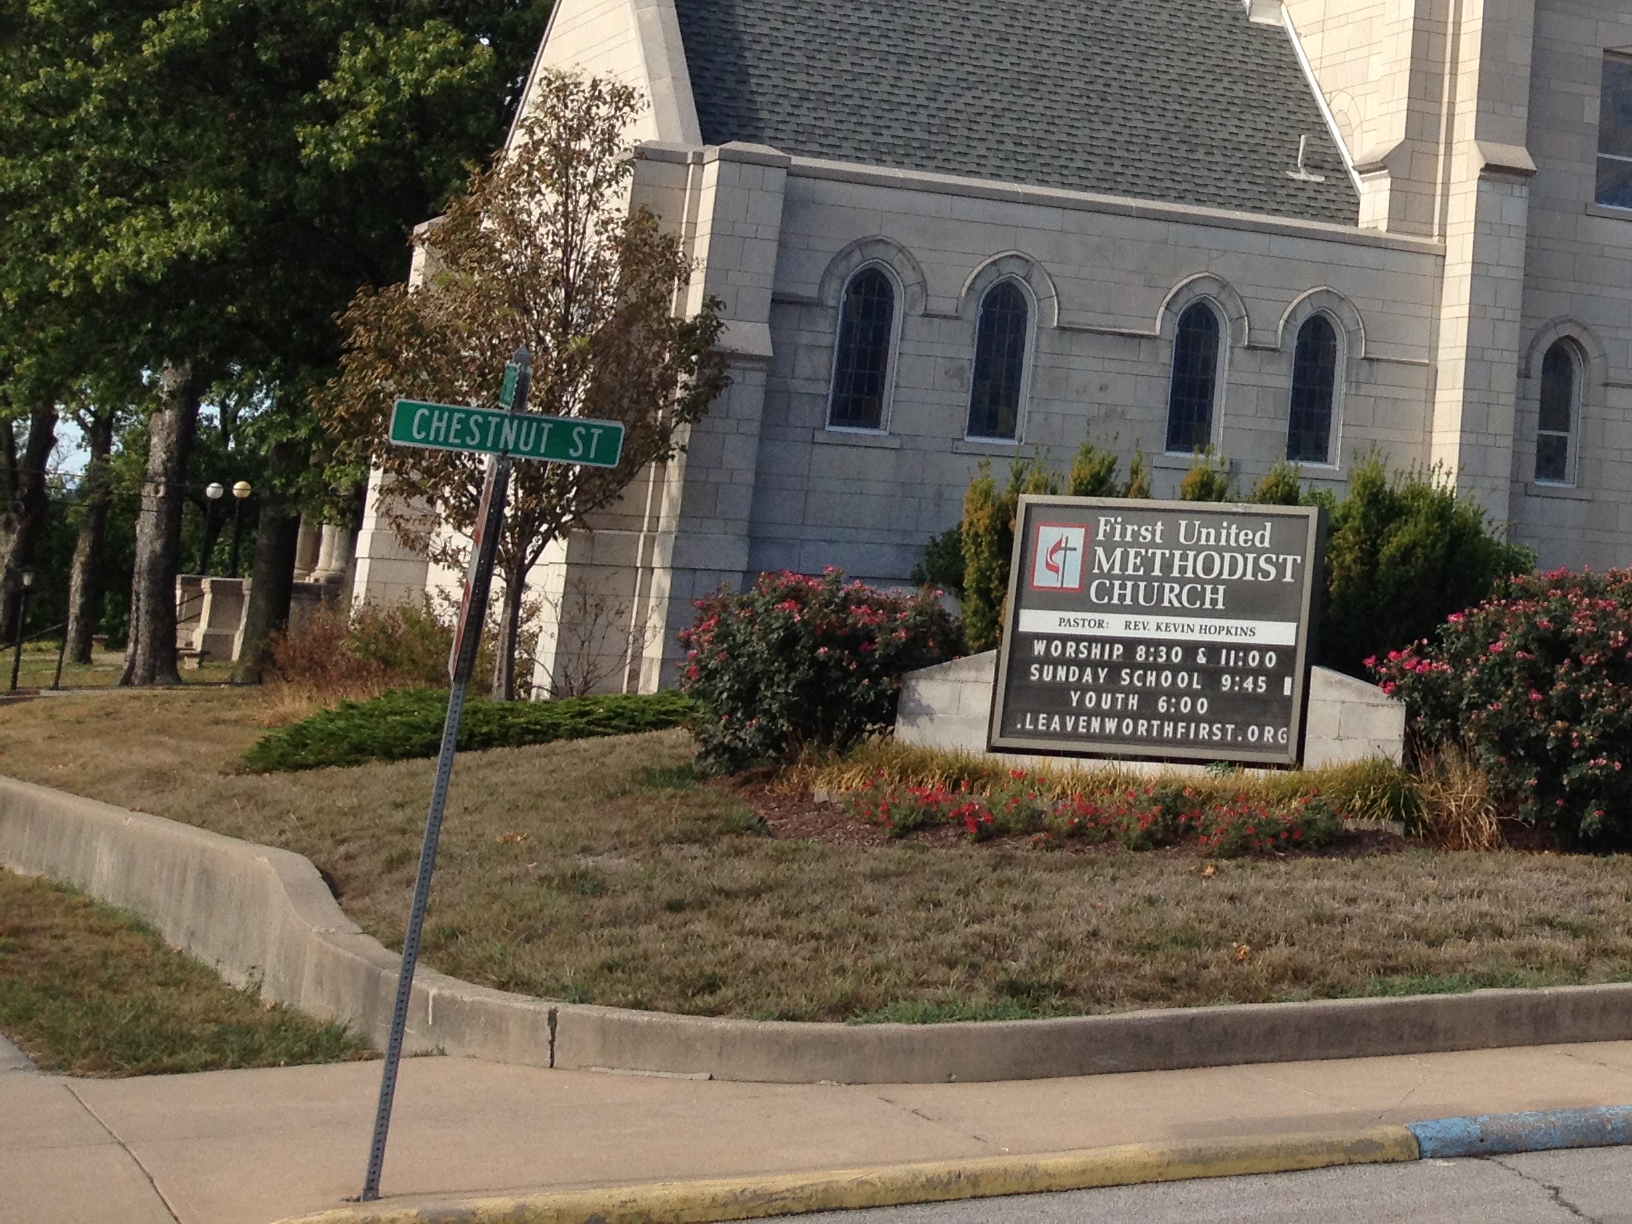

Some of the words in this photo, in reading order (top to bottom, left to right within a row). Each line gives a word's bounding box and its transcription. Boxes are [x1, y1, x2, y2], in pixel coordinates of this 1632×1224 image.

[412, 408, 553, 453] CHESTNUT
[569, 426, 603, 459] ST
[1095, 516, 1165, 544] First
[1178, 519, 1272, 548] United
[1092, 546, 1302, 583] METHODIST
[1089, 579, 1227, 610] CHURCH
[1124, 620, 1151, 632] REV.
[1155, 622, 1195, 634] KEVIN
[1198, 624, 1257, 637] HOPKINS
[1033, 639, 1124, 661] WORSHIP
[1135, 645, 1183, 663] 8:30
[1196, 648, 1208, 664] &
[1220, 648, 1277, 668] 11:00
[1030, 664, 1109, 684] SUNDAY
[1120, 668, 1202, 689] SCHOOL
[1221, 674, 1268, 693] 9:45
[1070, 690, 1139, 711] YOUTH
[1158, 696, 1209, 714] 6:00
